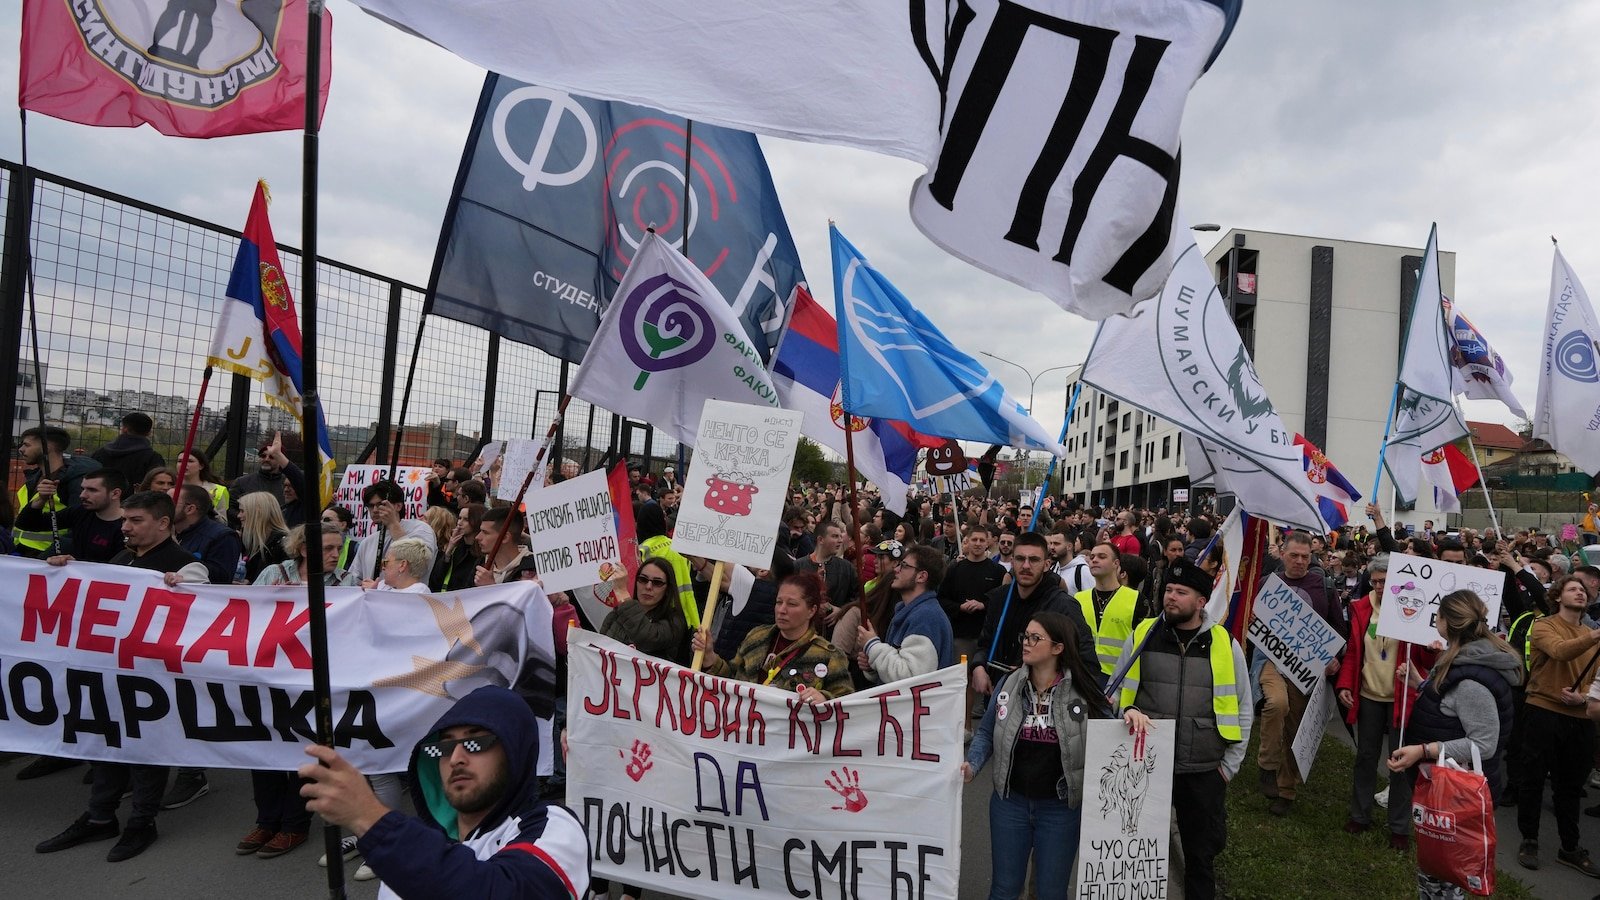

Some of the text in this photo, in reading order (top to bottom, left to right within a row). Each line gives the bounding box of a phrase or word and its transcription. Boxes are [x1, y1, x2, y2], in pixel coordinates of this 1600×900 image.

[71, 0, 278, 104] СИНГИДУНУМ
[1173, 285, 1235, 423] ШУМАРСКИ
[1245, 419, 1259, 435] У
[703, 420, 788, 448] НЕШТО СЕ
[714, 442, 770, 468] КРЧКА
[348, 469, 406, 484] МИ ОВЕ
[530, 492, 612, 534] ЈЕРКОВИЋ НАЦИЈА
[718, 515, 730, 528] У
[536, 546, 573, 574] ПРОТИВ
[576, 536, 616, 564] ЋАЦИЈА
[676, 521, 774, 554] ЈЕРКОВИЋУ
[1396, 563, 1432, 580] ДО
[20, 573, 334, 674] МЕДАК
[1260, 590, 1335, 666] КО ДА БРАНИ
[1274, 583, 1336, 645] ИМА ДЕЦУ
[1248, 617, 1317, 689] ЕРКОВЧАНИ
[584, 648, 766, 746] ЈЕРКОВИЋ
[1020, 728, 1058, 741] EAMS
[694, 752, 769, 822] ДА
[583, 797, 944, 900] ПОЧИСТИ СМЕЋЕ
[1092, 838, 1158, 860] ЧУО САМ
[1080, 878, 1166, 900] НЕШТО МОЈЕ
[1084, 858, 1166, 884] ДА ИМАТЕ
